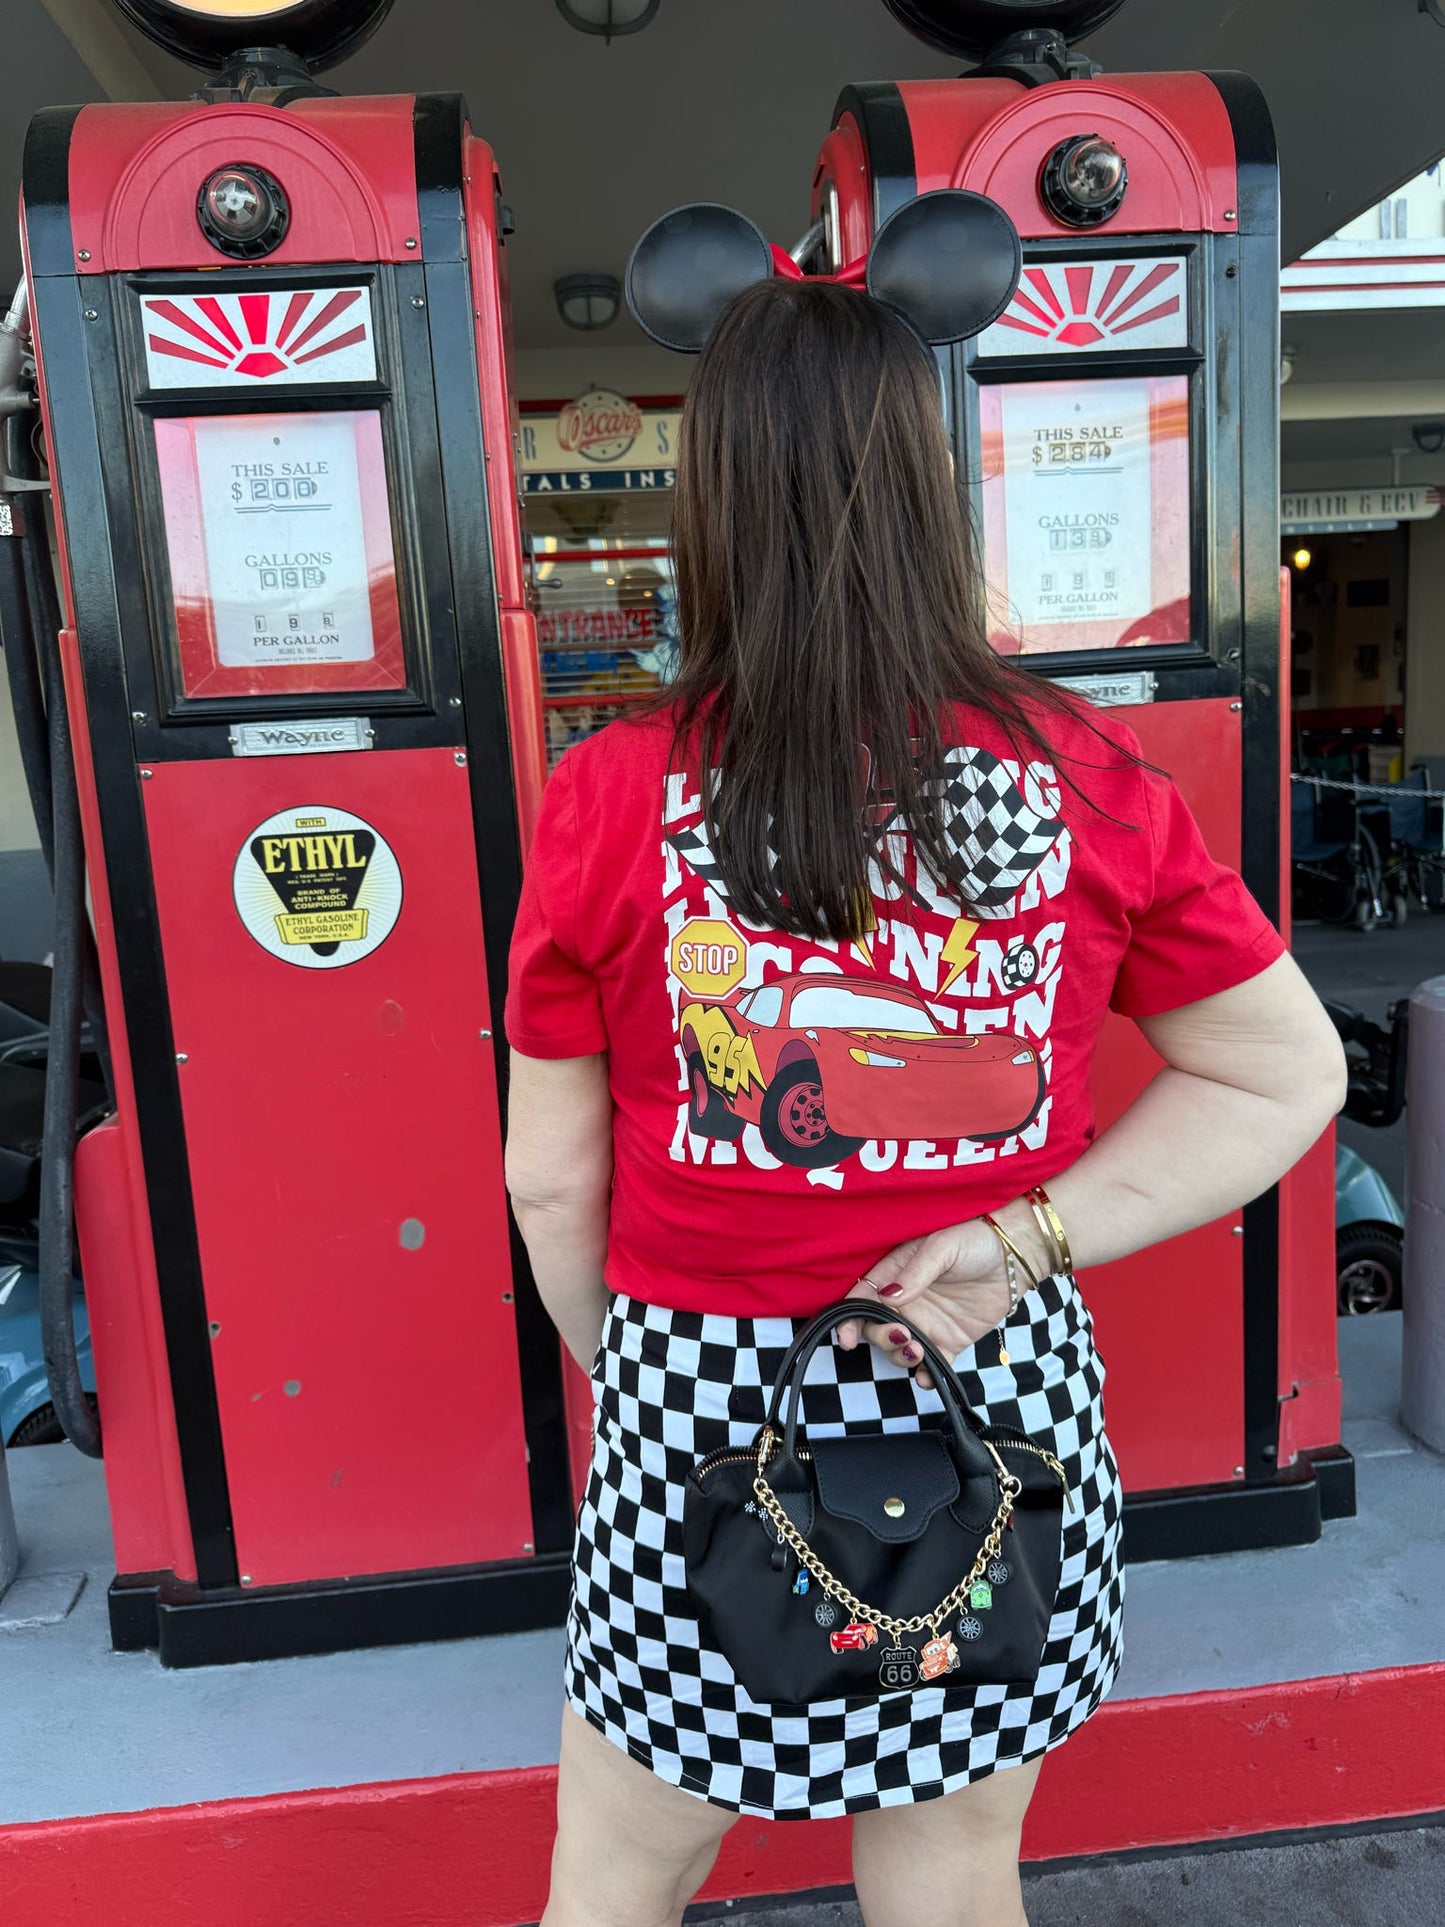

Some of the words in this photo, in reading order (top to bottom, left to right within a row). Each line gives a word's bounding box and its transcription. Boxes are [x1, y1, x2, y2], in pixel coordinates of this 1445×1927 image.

[558, 403, 643, 452] Oscar's
[1033, 428, 1074, 441] THIS
[1079, 426, 1123, 440] SALE
[230, 463, 275, 477] THIS
[281, 461, 330, 476] SALE
[624, 470, 675, 489] INS
[1038, 513, 1119, 528] GALLONS
[244, 552, 333, 568] GALLONS
[1039, 593, 1062, 605] PER
[1066, 591, 1119, 604] GALLON
[253, 636, 280, 647] PER
[283, 634, 340, 646] GALLON
[1087, 683, 1131, 698] yne
[257, 727, 346, 747] Wayne
[299, 819, 322, 827] WITH
[262, 834, 367, 874] ETHYL
[296, 888, 325, 897] BRAND
[294, 900, 347, 910] COMPOUND
[285, 916, 314, 927] ETHYL
[316, 913, 360, 925] GASOLINE
[293, 922, 354, 935] CORPORATION
[678, 941, 738, 976] STOP
[707, 1031, 749, 1100] 95
[885, 1651, 912, 1661] ROUTE
[887, 1664, 912, 1683] 66
